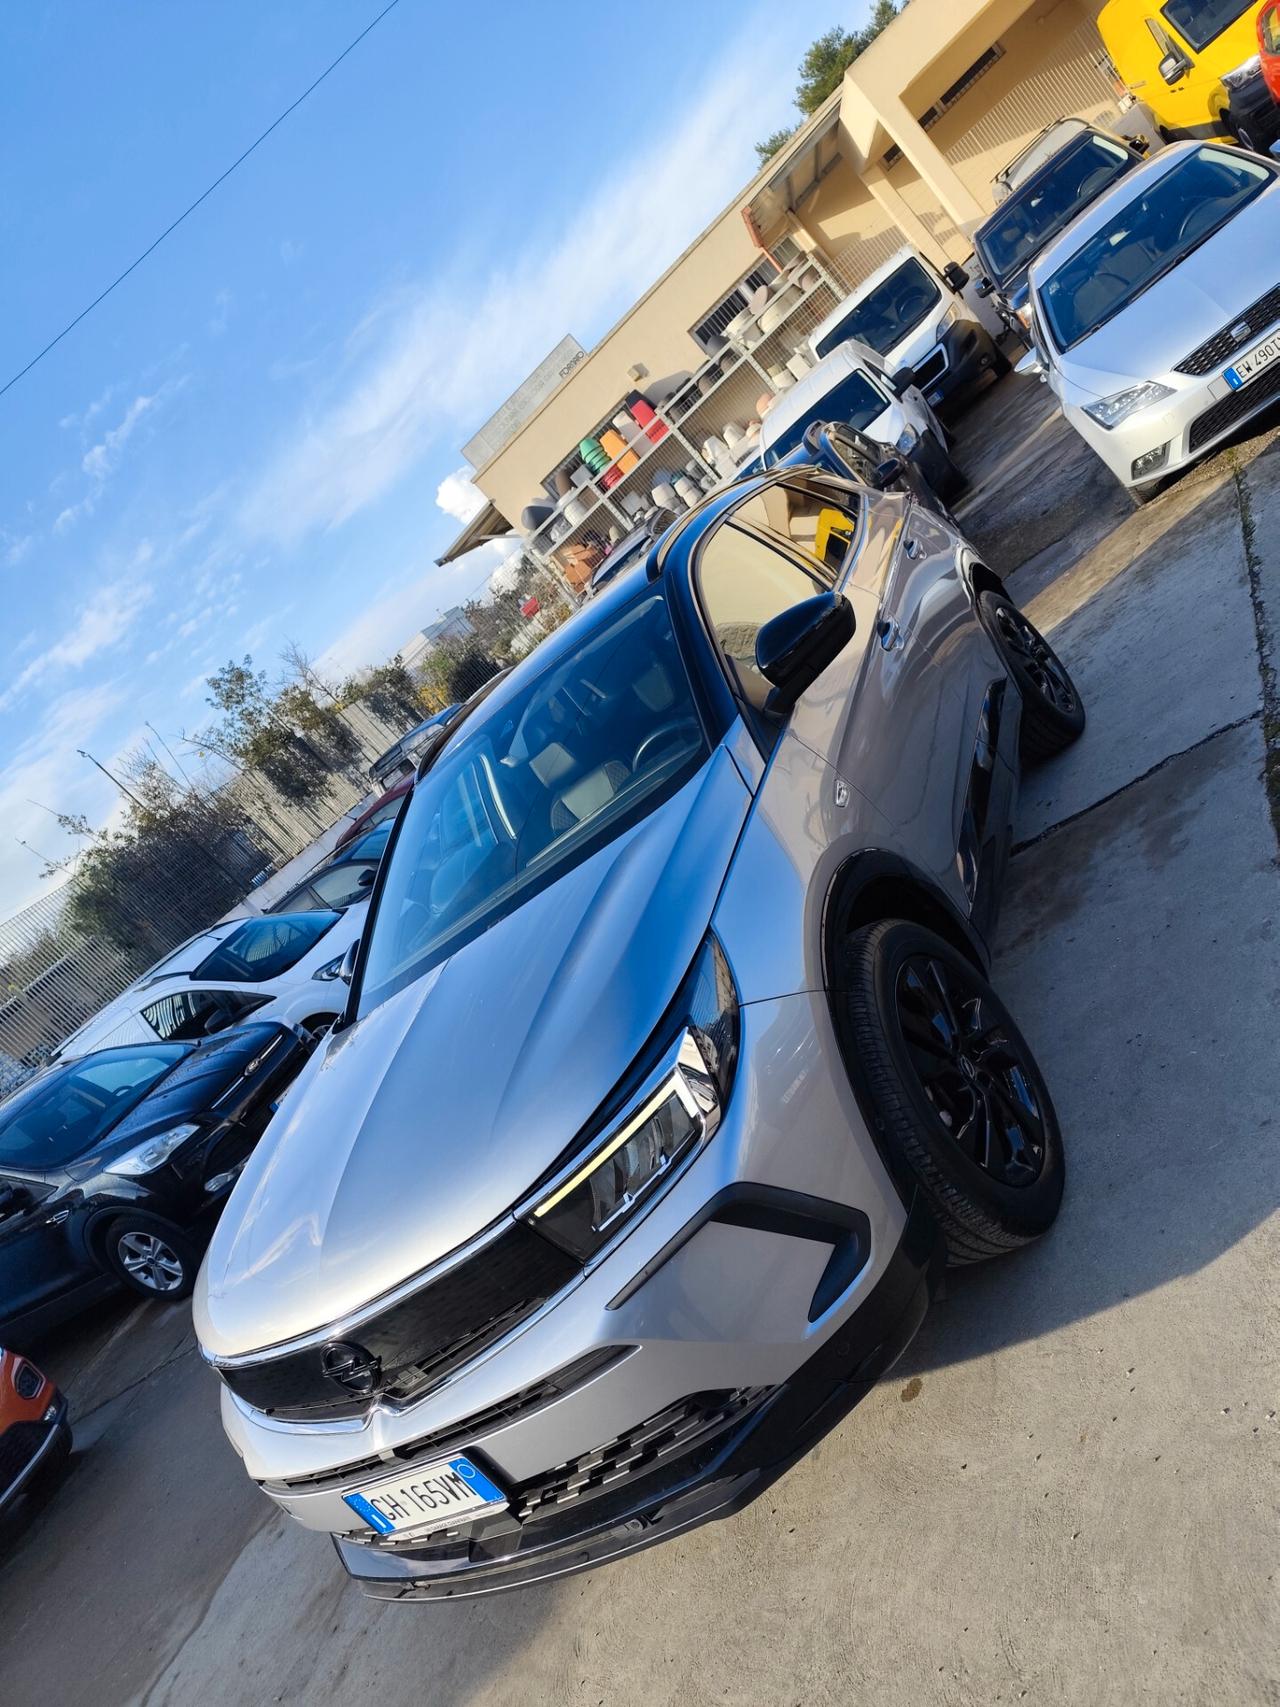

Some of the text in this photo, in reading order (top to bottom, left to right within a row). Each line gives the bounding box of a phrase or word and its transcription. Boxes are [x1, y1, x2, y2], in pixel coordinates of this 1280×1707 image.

[1236, 360, 1253, 378] EW
[1255, 336, 1280, 366] 490T
[370, 1493, 411, 1521] GH
[400, 1471, 477, 1512] 165VM
